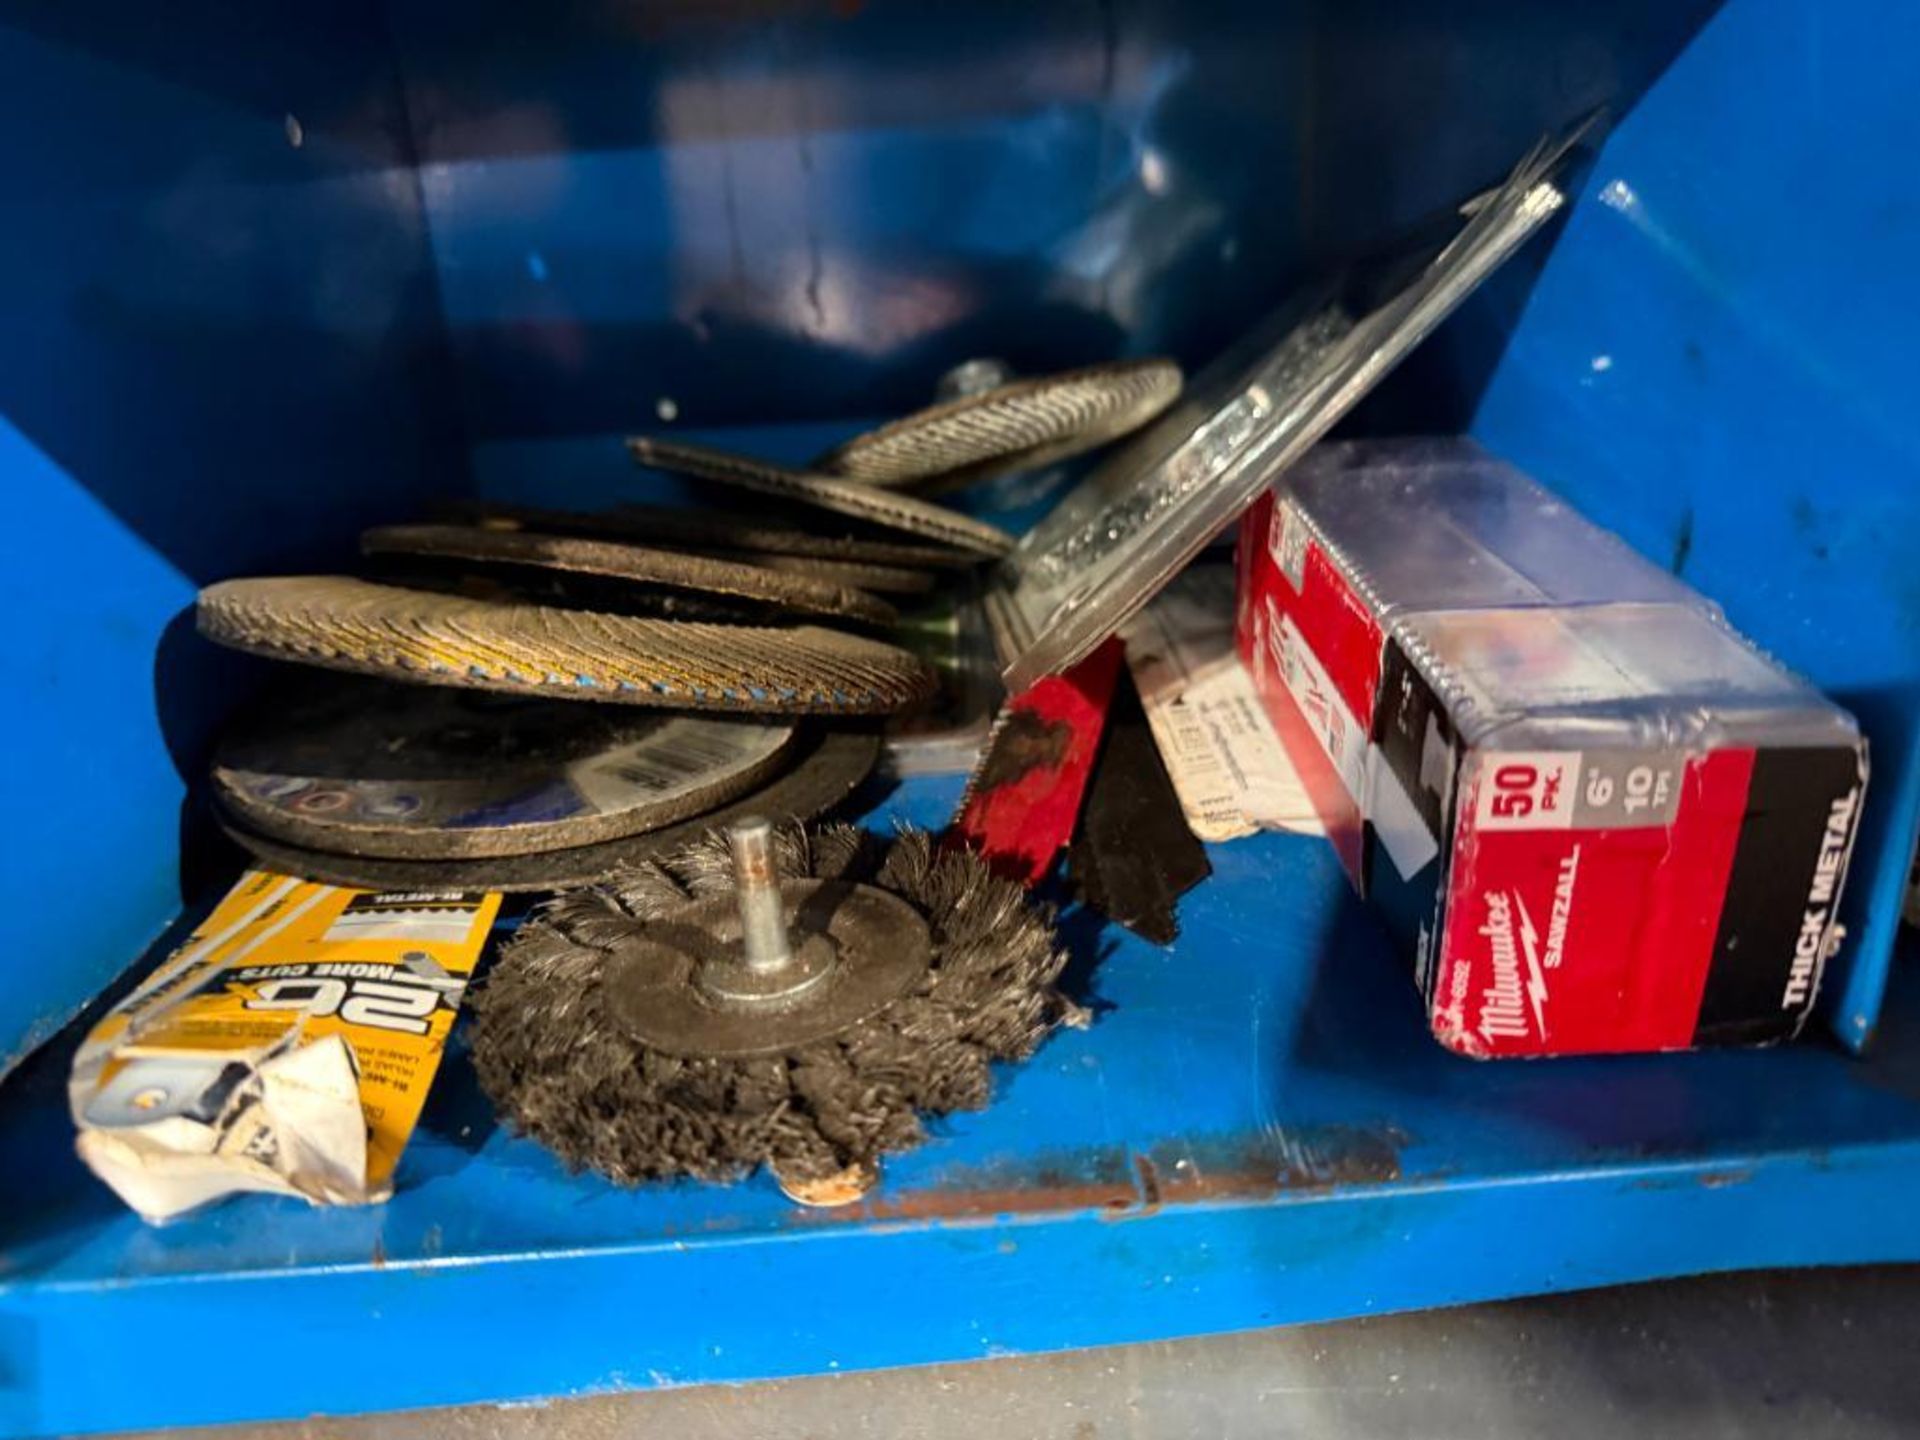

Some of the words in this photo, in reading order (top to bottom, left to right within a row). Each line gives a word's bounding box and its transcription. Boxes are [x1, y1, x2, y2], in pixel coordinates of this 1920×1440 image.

[1491, 765, 1538, 818] 50
[1542, 766, 1563, 811] PK.
[1623, 766, 1653, 814] 10
[1653, 770, 1672, 808] TPI
[1543, 843, 1580, 969] SAWZALL
[1782, 909, 1827, 1010] THICK
[1809, 787, 1858, 903] METAL
[239, 964, 310, 980] CUTS
[314, 963, 395, 981] MORE
[1477, 891, 1529, 1046] Milwaukee
